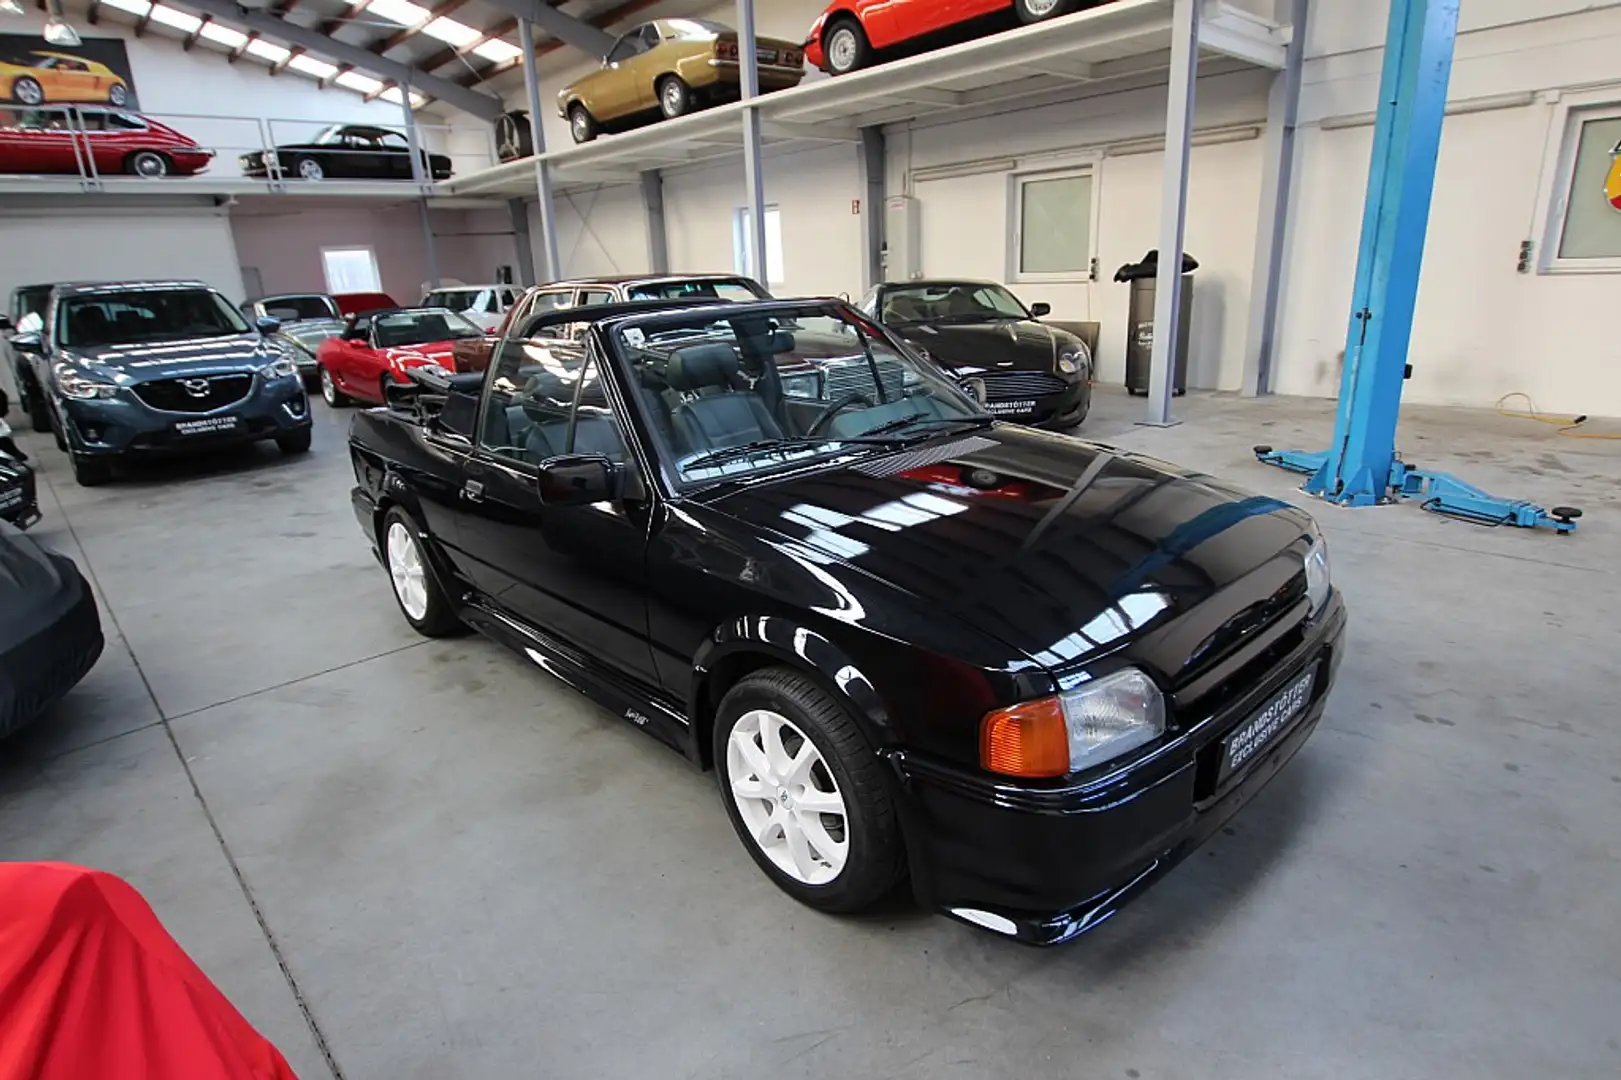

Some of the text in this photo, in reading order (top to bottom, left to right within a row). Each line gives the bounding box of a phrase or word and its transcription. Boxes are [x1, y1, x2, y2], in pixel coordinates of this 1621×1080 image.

[984, 400, 1036, 408] RANDSTÖTTER
[1229, 673, 1312, 756] BRANDSTÖTTER
[1231, 696, 1303, 768] EXCLUSIVE CARS
